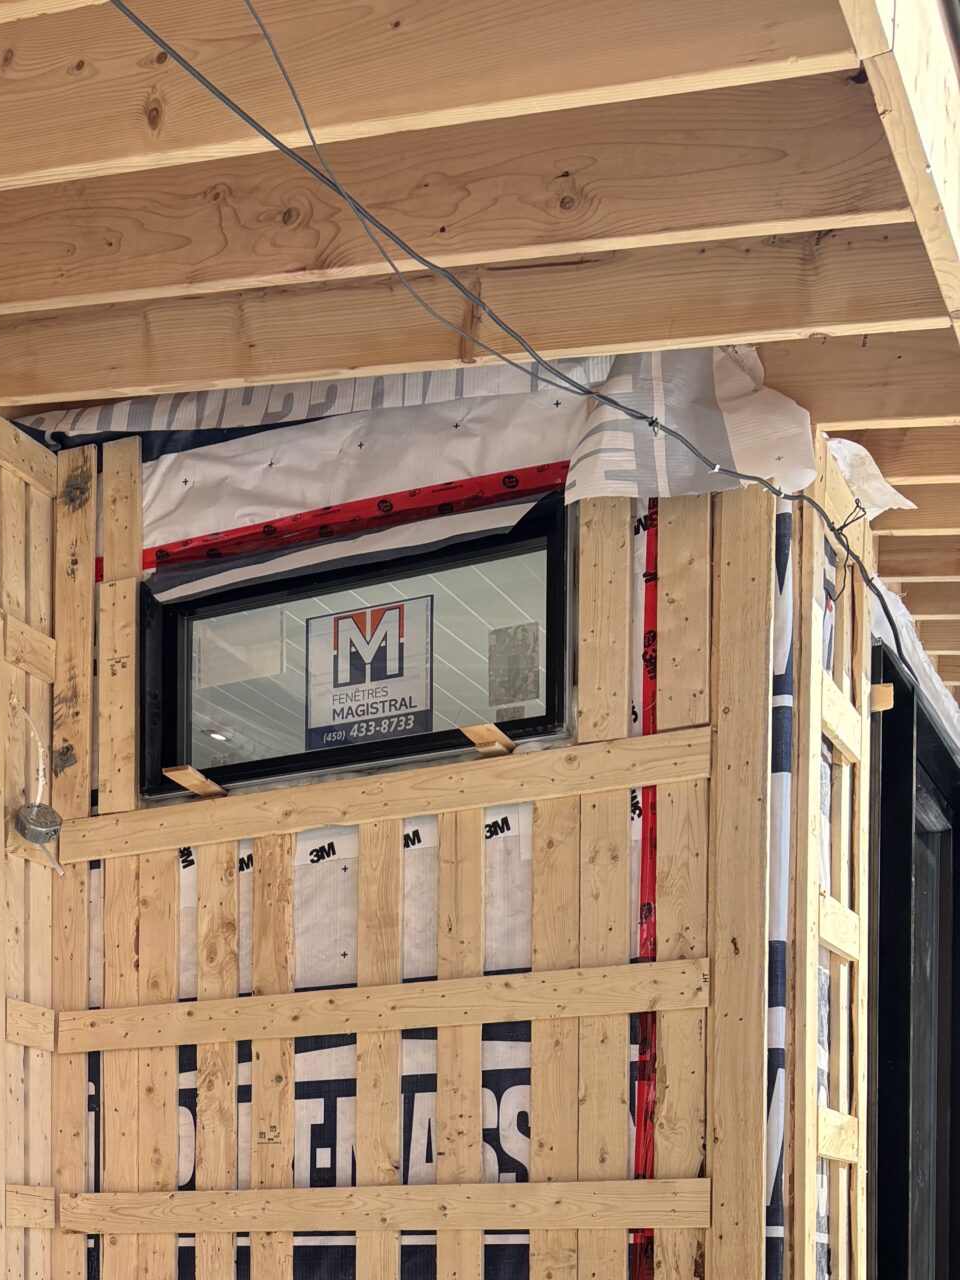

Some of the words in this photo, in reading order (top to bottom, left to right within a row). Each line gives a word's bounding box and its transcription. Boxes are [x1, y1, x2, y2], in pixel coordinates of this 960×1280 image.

[332, 686, 389, 705] FENÊTRES
[332, 696, 417, 721] MAGISTRAL
[323, 729, 346, 743] (450)
[349, 715, 415, 738] 433-8733
[485, 805, 512, 840] 3M
[309, 841, 337, 864] 3M
